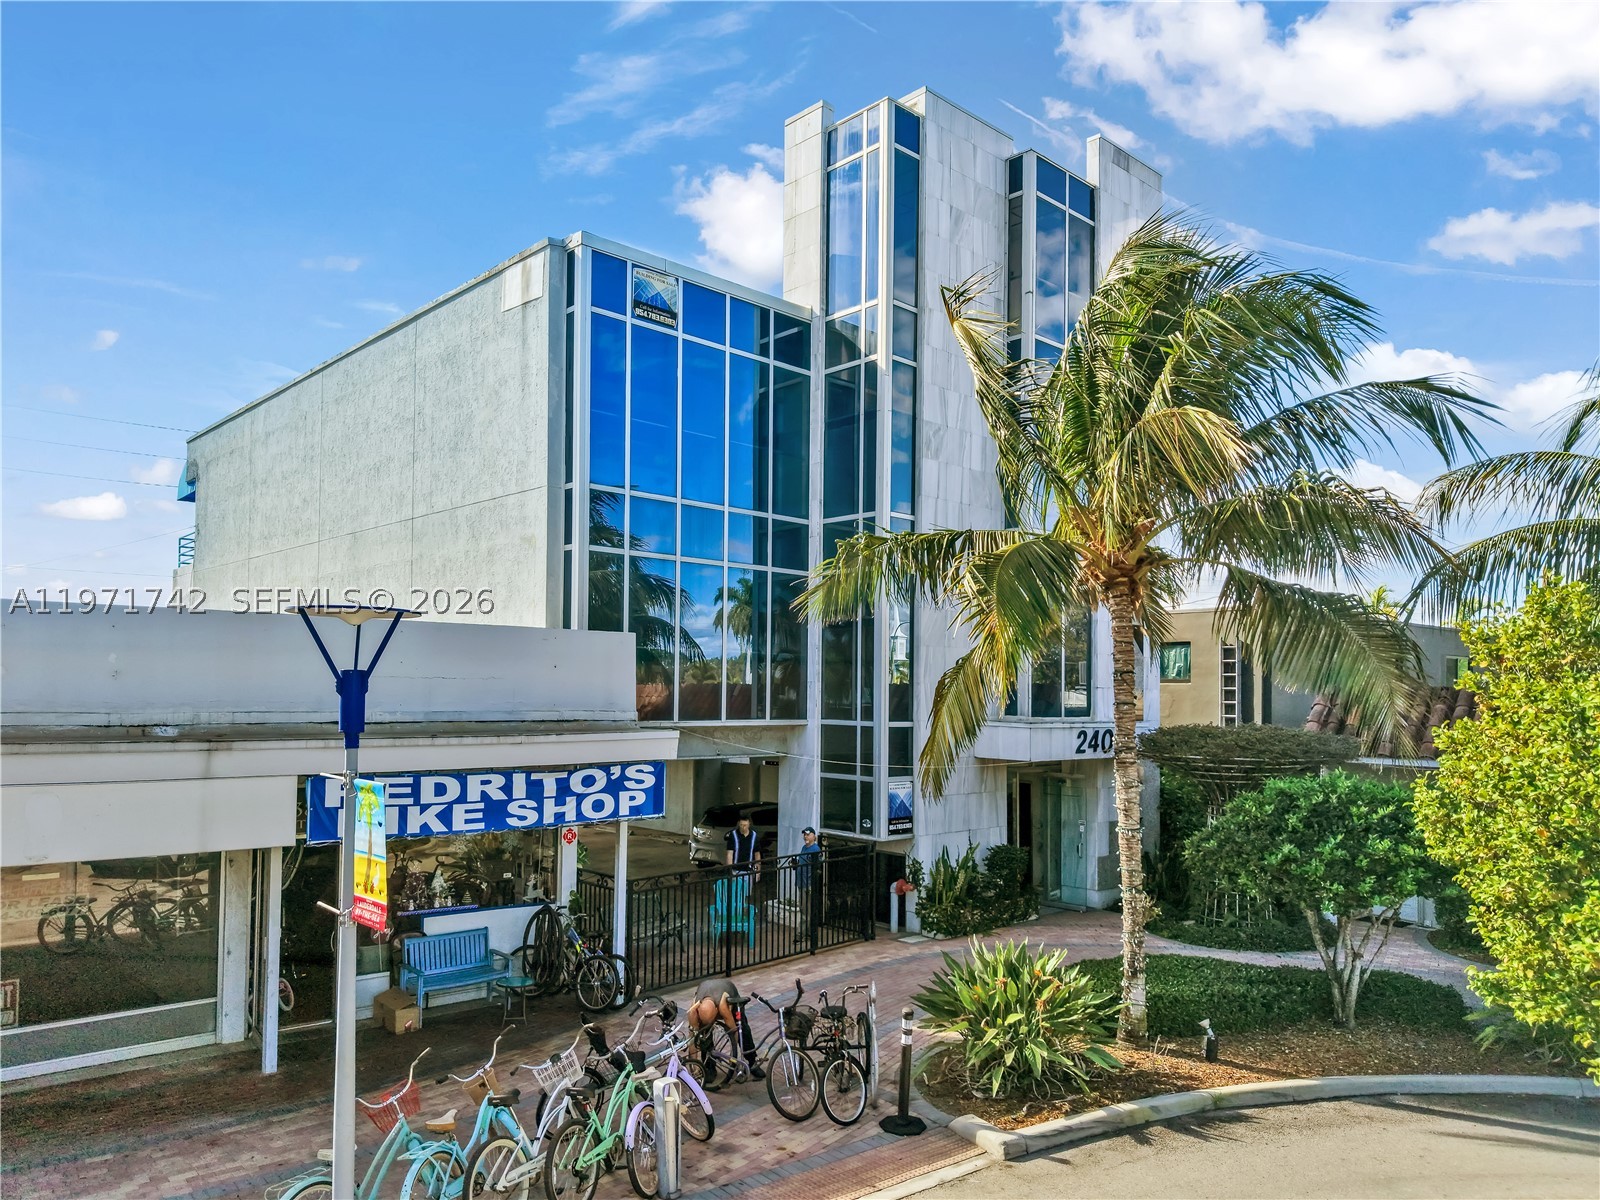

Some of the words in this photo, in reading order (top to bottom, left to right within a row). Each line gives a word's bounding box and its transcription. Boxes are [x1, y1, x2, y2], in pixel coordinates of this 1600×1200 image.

[1075, 729, 1114, 754] 240
[338, 802, 485, 837] IKE
[505, 790, 647, 827] SHOP
